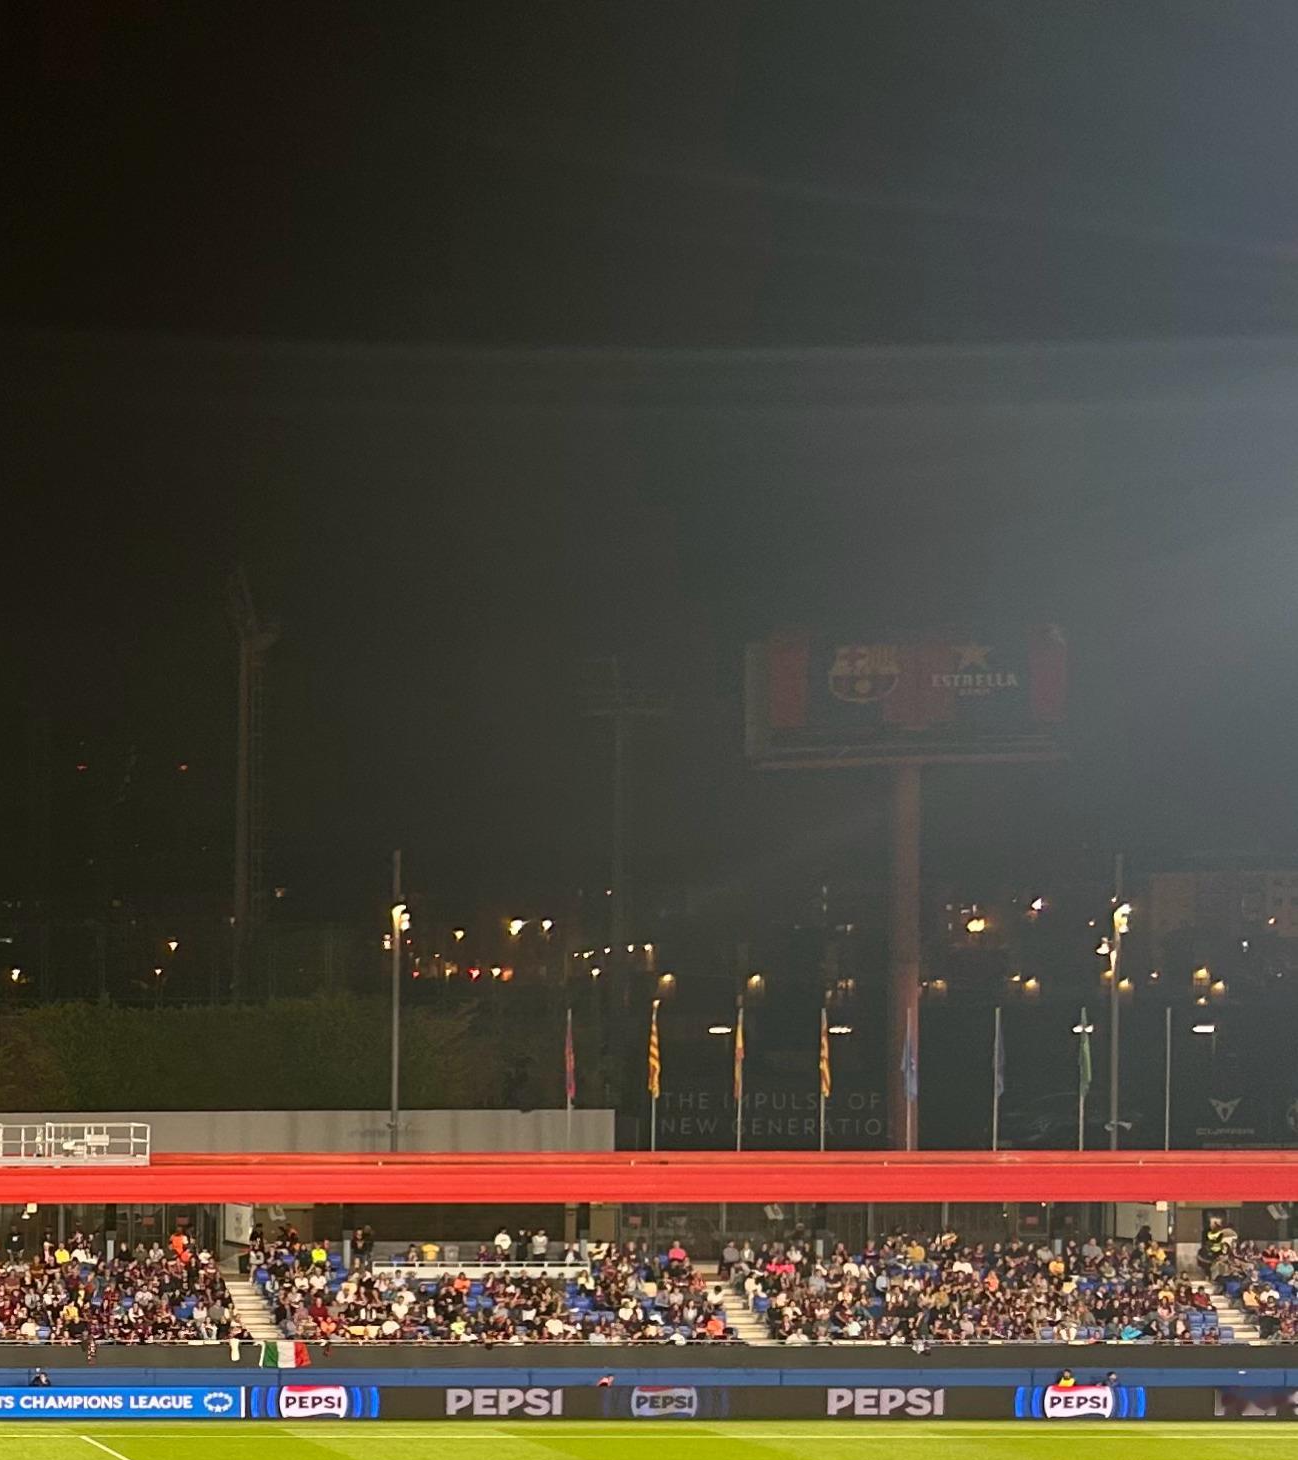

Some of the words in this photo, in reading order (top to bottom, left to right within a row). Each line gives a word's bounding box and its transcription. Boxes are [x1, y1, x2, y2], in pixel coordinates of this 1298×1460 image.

[931, 673, 1020, 687] ESTRELLA
[663, 1091, 709, 1110] THE
[848, 1092, 881, 1110] OF
[660, 1117, 718, 1135] NEW
[19, 1395, 123, 1409] CHAMPIONS
[130, 1395, 193, 1409] LEAGUE
[285, 1395, 341, 1409] PEPSI
[446, 1388, 563, 1416] PEPSI
[636, 1395, 693, 1410] PEPSI
[827, 1388, 944, 1416] PEPSI
[1050, 1396, 1107, 1410] PEPSI
